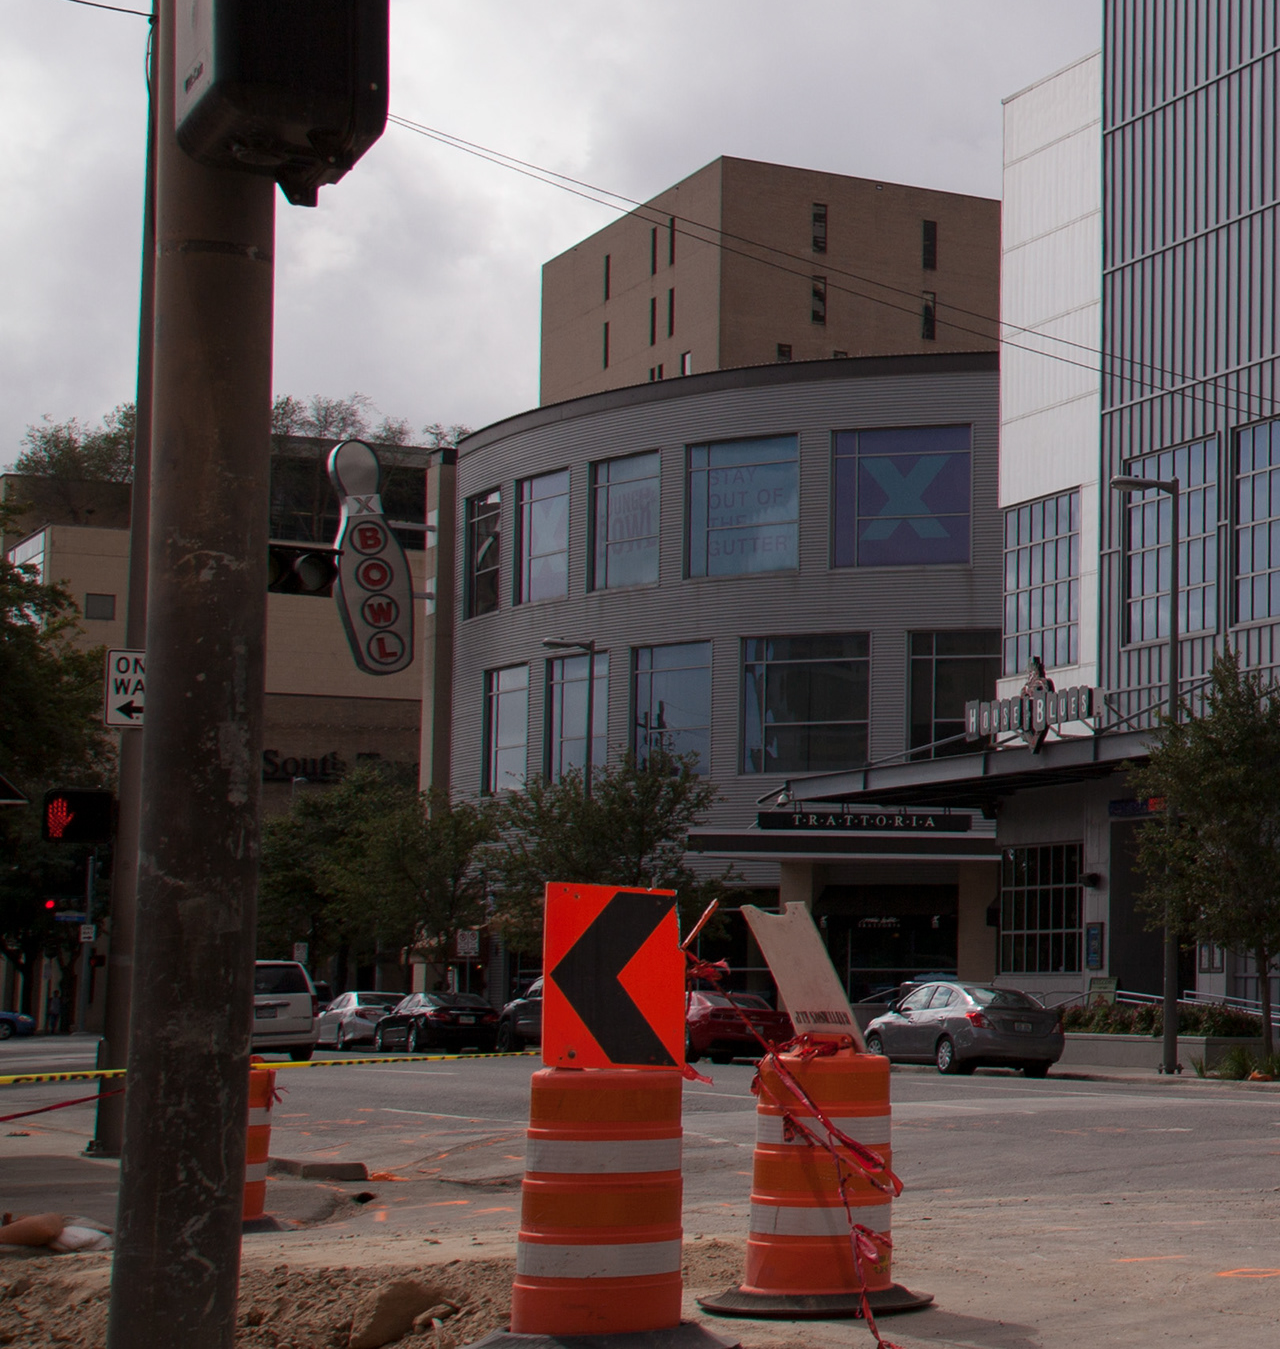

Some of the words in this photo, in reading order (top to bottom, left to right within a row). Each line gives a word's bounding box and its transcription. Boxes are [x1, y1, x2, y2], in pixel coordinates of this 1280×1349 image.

[710, 467, 757, 486] STAY
[352, 496, 376, 515] X
[709, 490, 748, 510] OUT
[757, 487, 784, 506] OF
[860, 454, 953, 541] X
[710, 514, 747, 528] THE
[357, 527, 398, 660] BOWL
[115, 656, 146, 675] ON
[113, 678, 146, 696] WA
[969, 705, 1019, 733] HOUSE
[1036, 695, 1087, 723] BLUES
